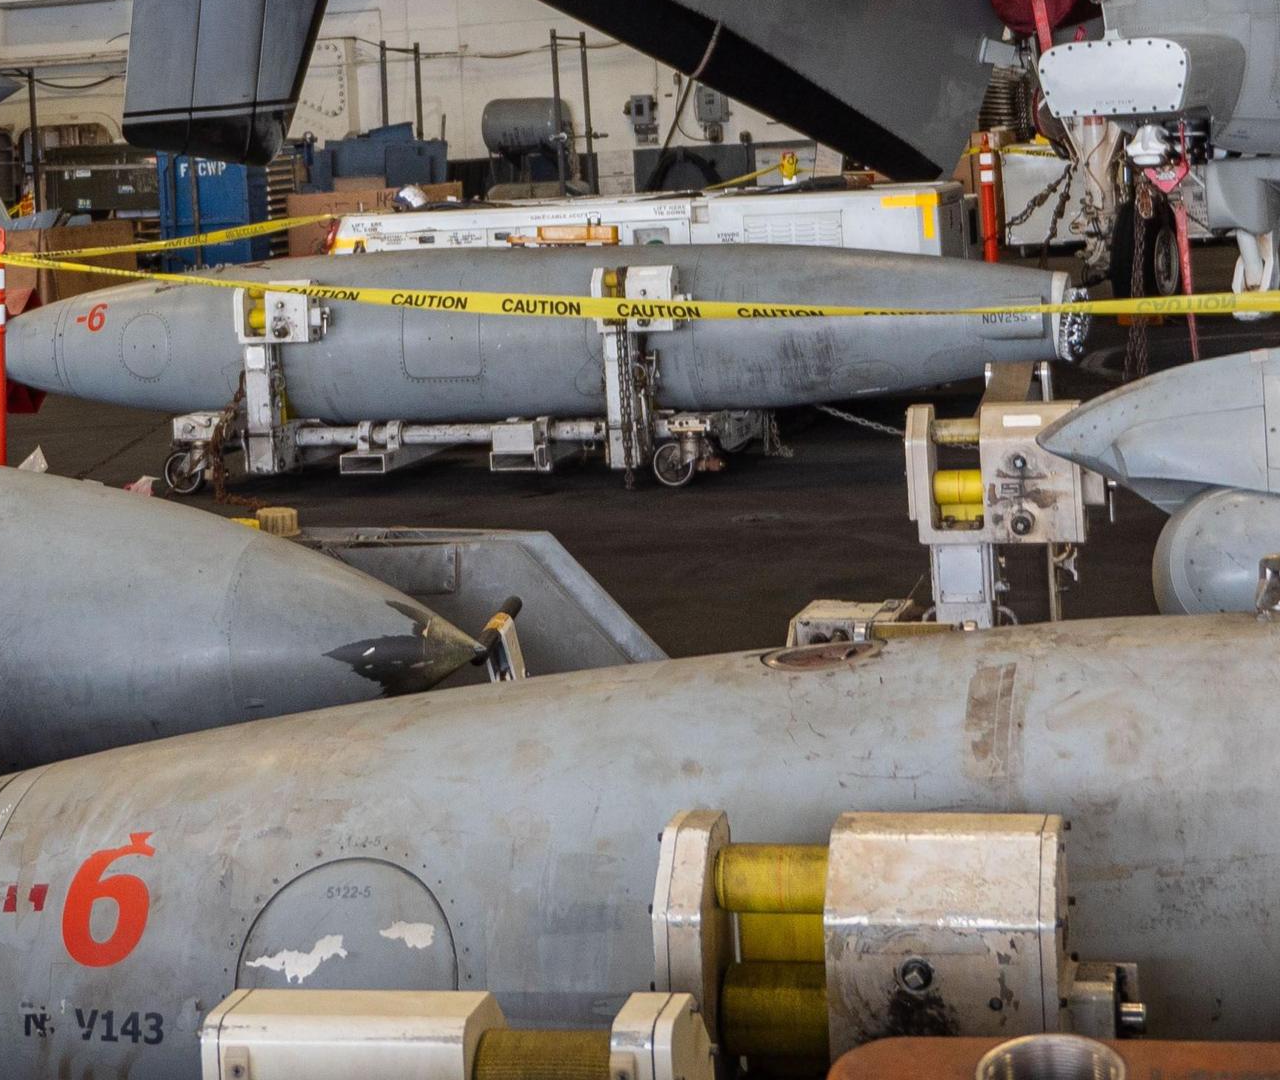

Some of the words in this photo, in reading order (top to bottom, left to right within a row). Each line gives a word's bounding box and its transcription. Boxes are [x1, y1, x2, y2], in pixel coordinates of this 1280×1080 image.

[391, 293, 468, 310] CAUTION
[501, 298, 581, 316] CAUTION
[617, 303, 701, 319] CAUTION
[326, 885, 372, 899] 5122-5
[75, 1008, 164, 1045] V143
